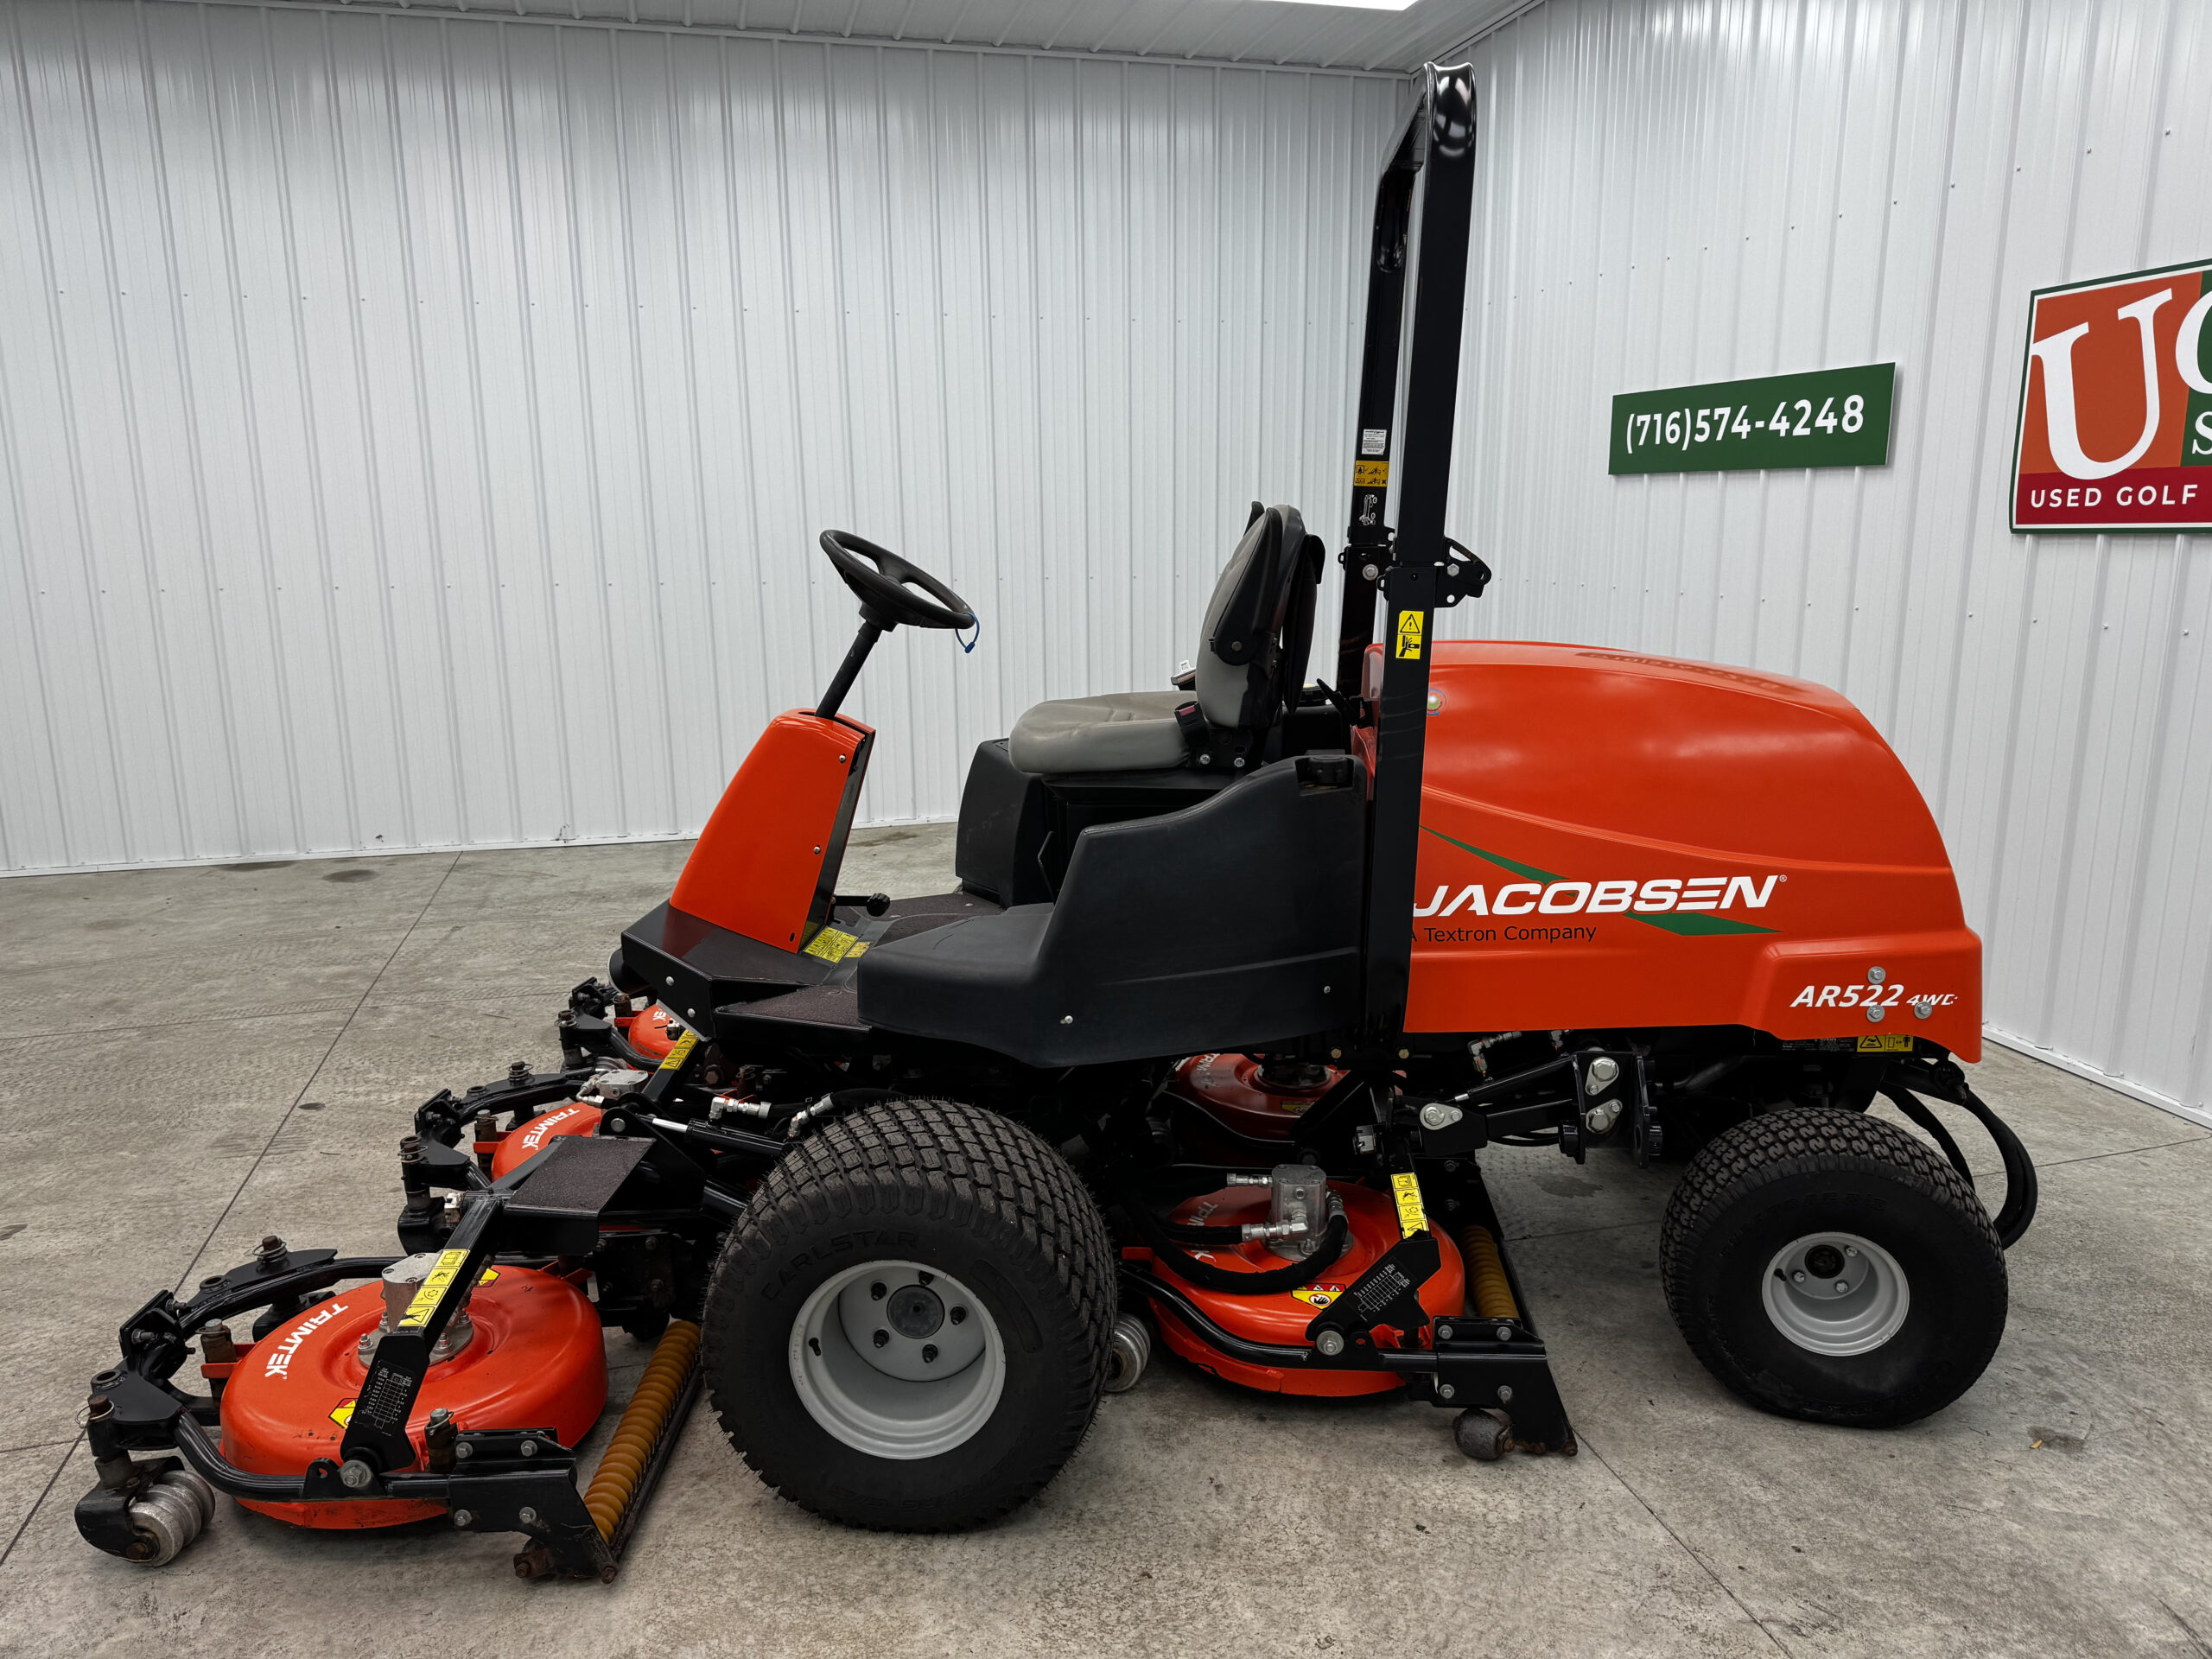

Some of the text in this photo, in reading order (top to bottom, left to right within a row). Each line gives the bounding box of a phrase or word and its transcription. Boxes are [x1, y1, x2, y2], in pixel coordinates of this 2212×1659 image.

[1626, 394, 1865, 454] (716)574-4248
[2031, 484, 2198, 509] USED GOLF
[1423, 926, 1497, 943] Textron
[1503, 925, 1598, 944] Company
[1789, 983, 1904, 1008] AR522
[521, 1108, 581, 1151] TRIMTEK
[264, 1303, 349, 1379] TRIMTEK
